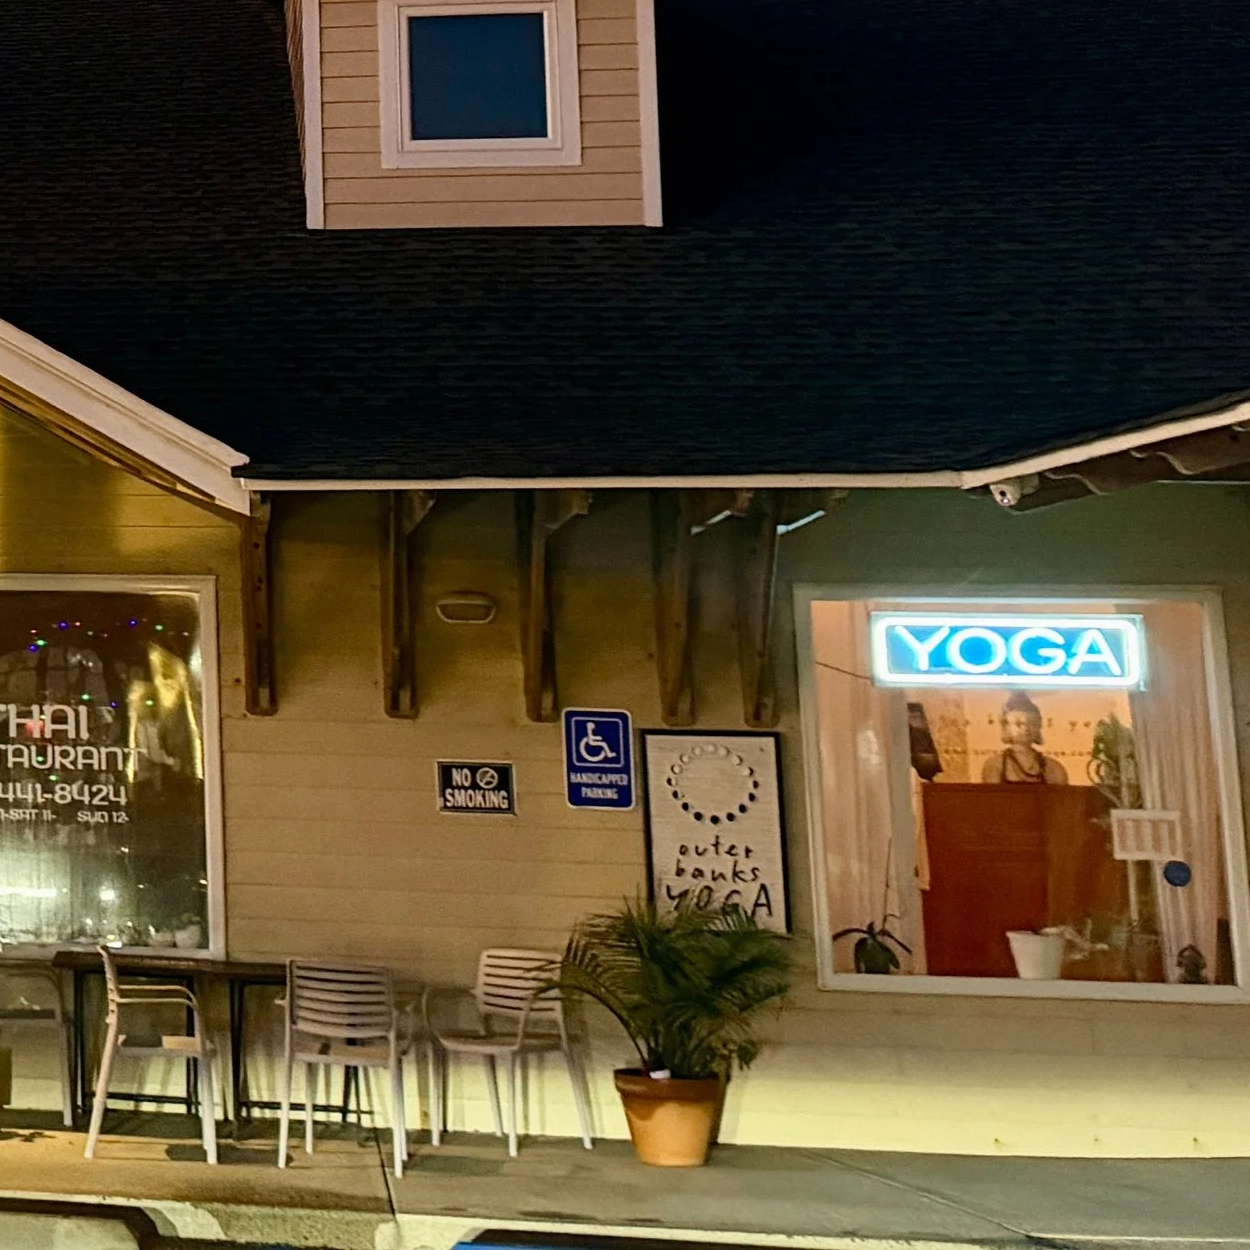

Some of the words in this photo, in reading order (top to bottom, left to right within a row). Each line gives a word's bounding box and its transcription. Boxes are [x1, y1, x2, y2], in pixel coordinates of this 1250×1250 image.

[894, 624, 1122, 676] YOGA
[451, 767, 472, 787] NO
[569, 771, 629, 786] HANDICAPPED
[444, 788, 509, 809] SMOKING
[581, 786, 619, 799] PARKING
[76, 810, 109, 824] SUN
[679, 835, 754, 858] outer
[675, 858, 760, 883] banks
